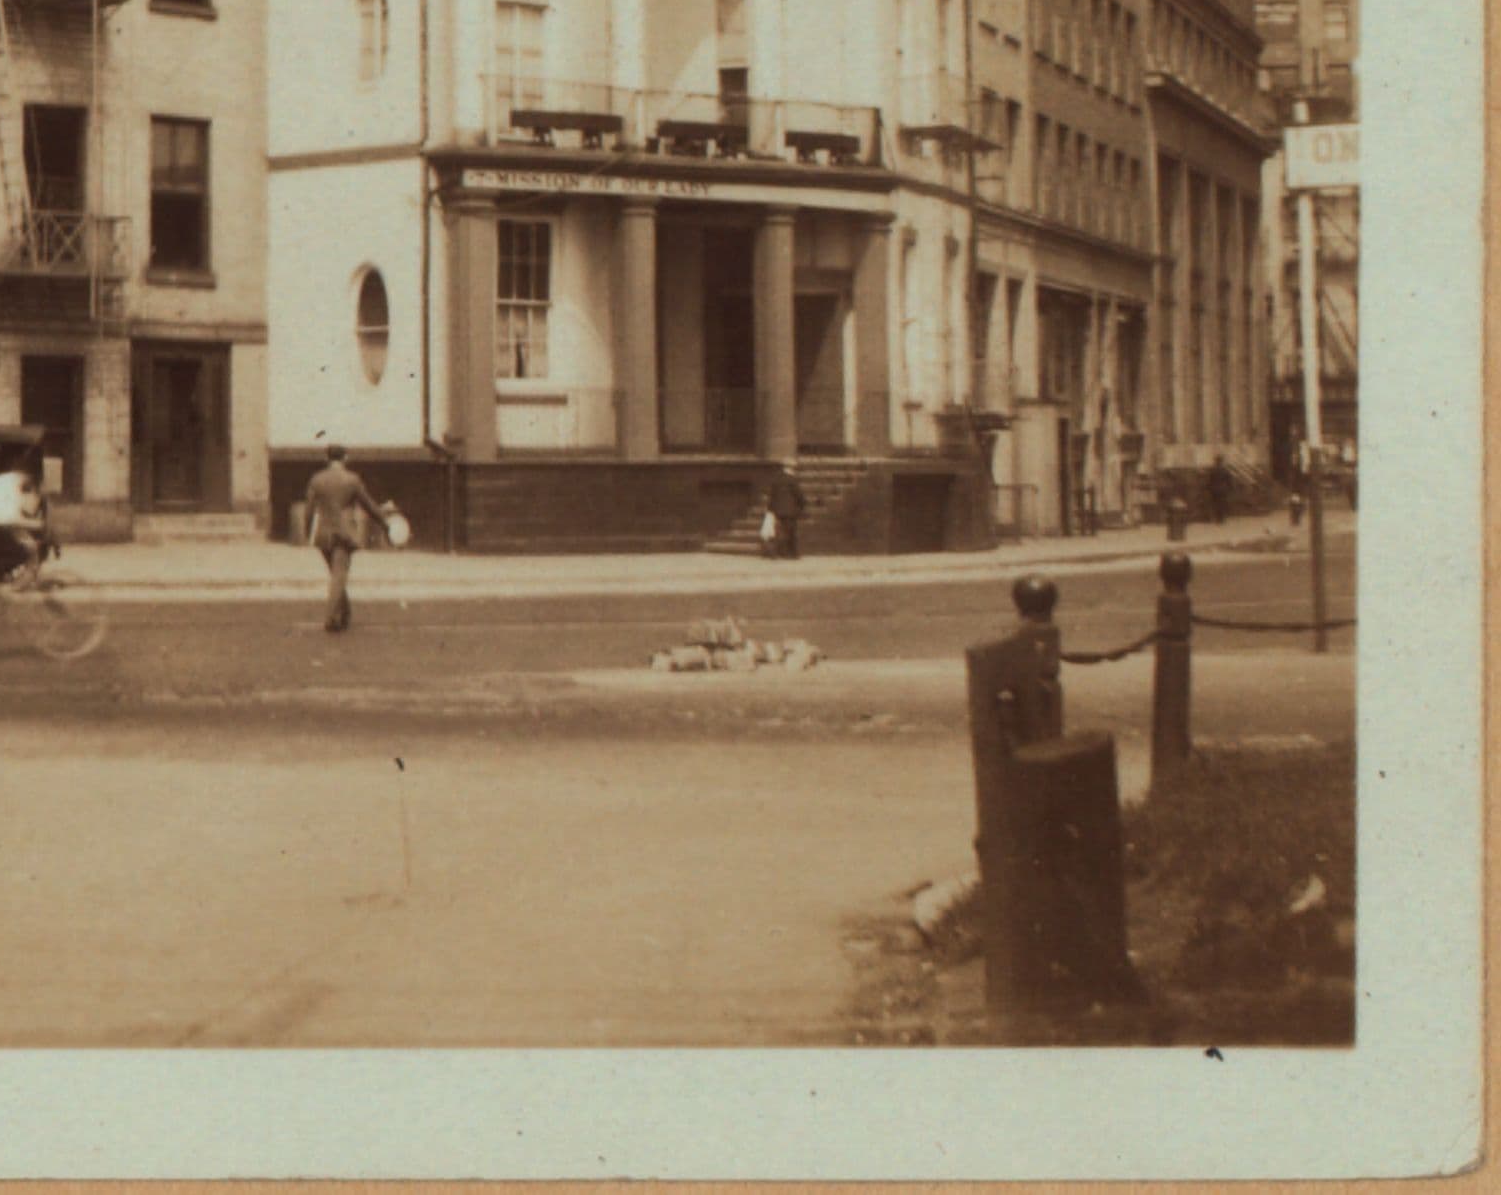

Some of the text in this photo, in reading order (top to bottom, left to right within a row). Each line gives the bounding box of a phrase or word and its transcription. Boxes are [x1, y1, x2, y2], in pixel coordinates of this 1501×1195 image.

[495, 172, 580, 190] MISSION
[589, 176, 608, 192] OF
[621, 177, 658, 194] OUR
[662, 181, 709, 197] LADY
